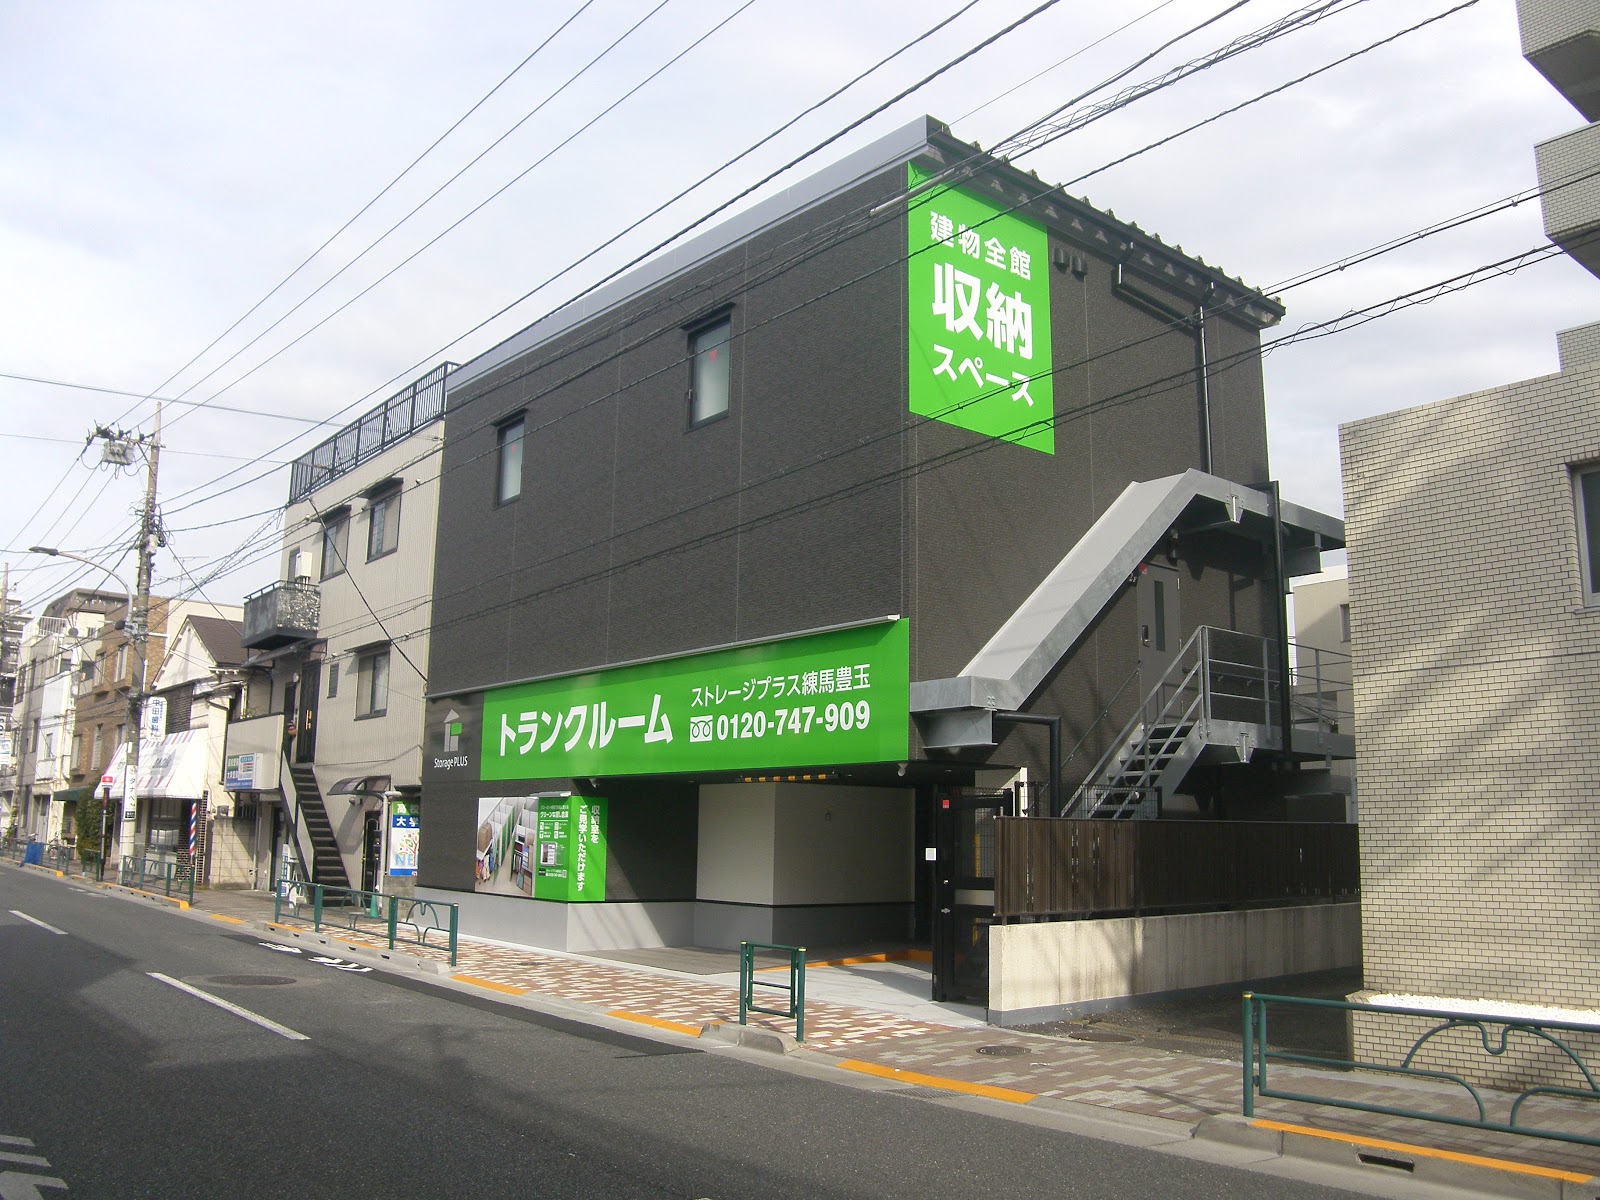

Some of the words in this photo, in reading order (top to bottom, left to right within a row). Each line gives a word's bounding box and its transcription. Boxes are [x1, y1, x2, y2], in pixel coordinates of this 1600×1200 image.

[930, 211, 1031, 280] 建物全館
[932, 262, 1033, 360] 収納
[933, 343, 1034, 407] スペース
[691, 663, 870, 708] ストレージプラス練馬豊玉
[500, 694, 673, 757] トランクルーム
[716, 700, 871, 741] 0120-747-909
[434, 758, 453, 770] Storage
[454, 756, 468, 767] PLUS
[396, 816, 419, 828] 大学
[577, 805, 588, 891] ご見学いただけます
[590, 805, 600, 843] 収納室を
